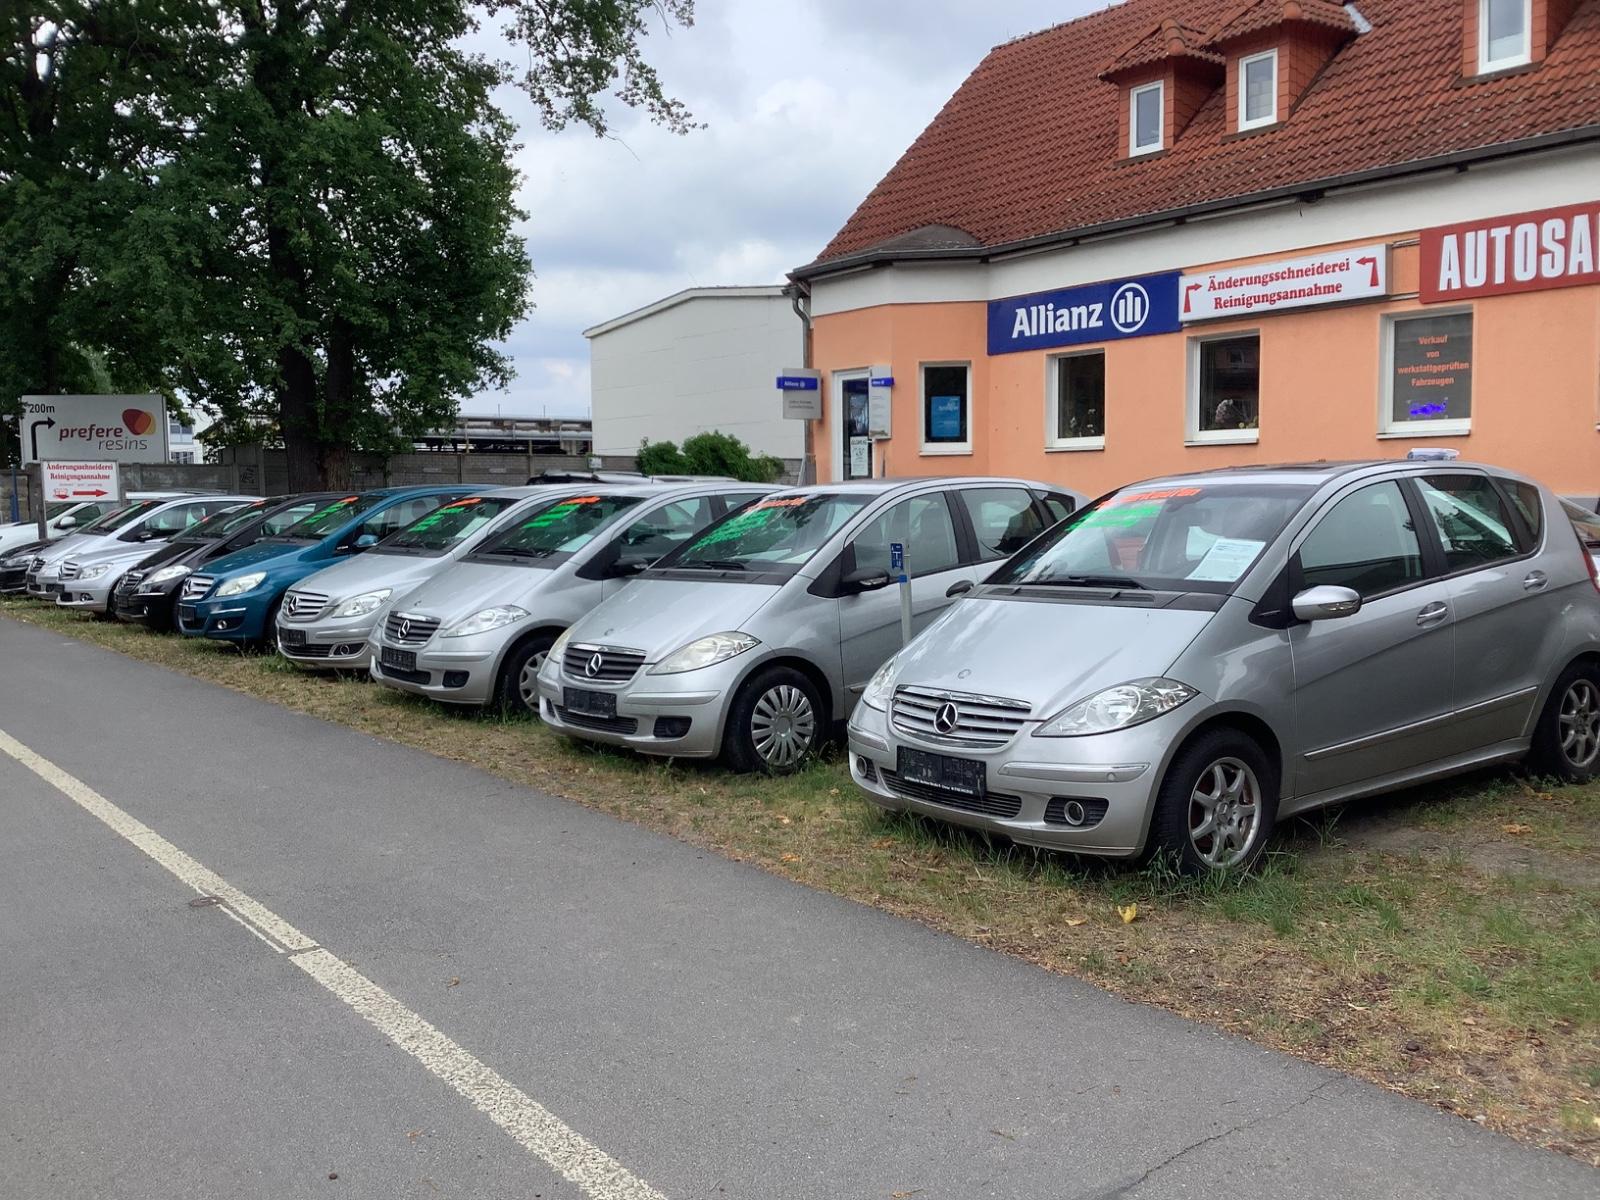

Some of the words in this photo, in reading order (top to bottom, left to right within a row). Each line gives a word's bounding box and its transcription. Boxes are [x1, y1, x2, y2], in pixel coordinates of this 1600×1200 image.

[1439, 213, 1600, 292] AUTOSA
[1208, 257, 1351, 292] Änderungsschneiderei
[1213, 282, 1343, 310] Reinigungsannahme
[1011, 302, 1104, 339] Allianz
[1418, 334, 1449, 345] Verkauf
[1426, 350, 1440, 358] von
[1397, 361, 1470, 375] werkstattgeprüften
[1411, 377, 1455, 387] Fahrzeugen
[29, 403, 56, 414] 200m
[59, 424, 124, 441] prefere
[98, 436, 148, 451] resins
[50, 472, 111, 481] Reinigungsannahme
